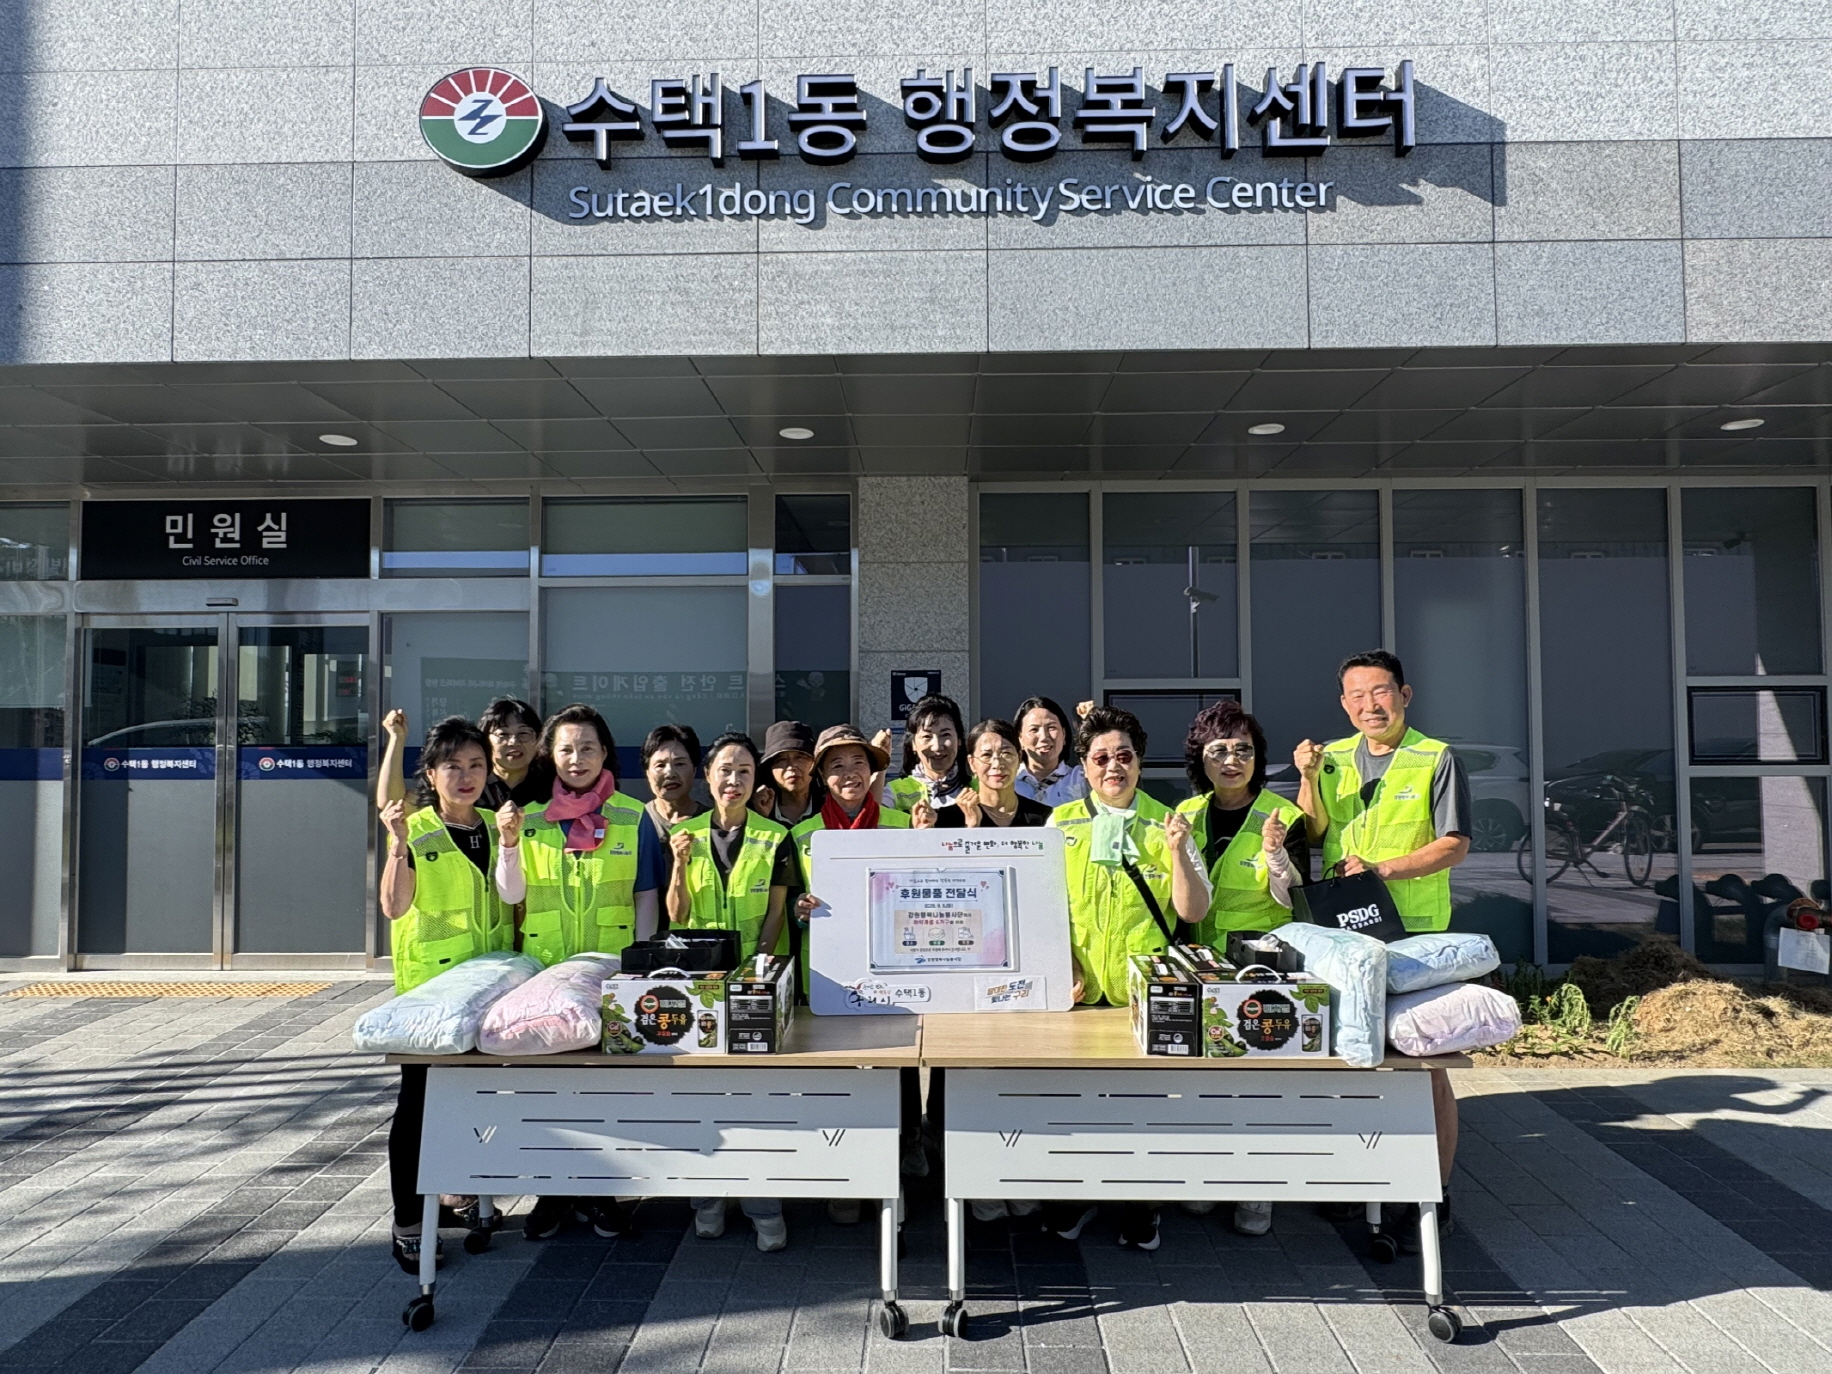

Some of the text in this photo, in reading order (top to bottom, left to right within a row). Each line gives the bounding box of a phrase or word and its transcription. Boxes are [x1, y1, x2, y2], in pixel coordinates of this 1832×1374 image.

[562, 60, 1416, 165] 수택1동 행정복지센터
[569, 175, 1334, 224] Sutaek1dong Community Service Center
[182, 555, 270, 566] Civil Service Office
[121, 759, 197, 769] 수택1동 행정복지센터
[276, 758, 353, 769] 수택1동 행정복지센터
[900, 887, 977, 899] 후원물품 전달식
[1336, 903, 1380, 928] PSDG
[1008, 979, 1026, 991] 도전
[895, 988, 926, 998] 수택1동
[1013, 989, 1030, 1000] 구리
